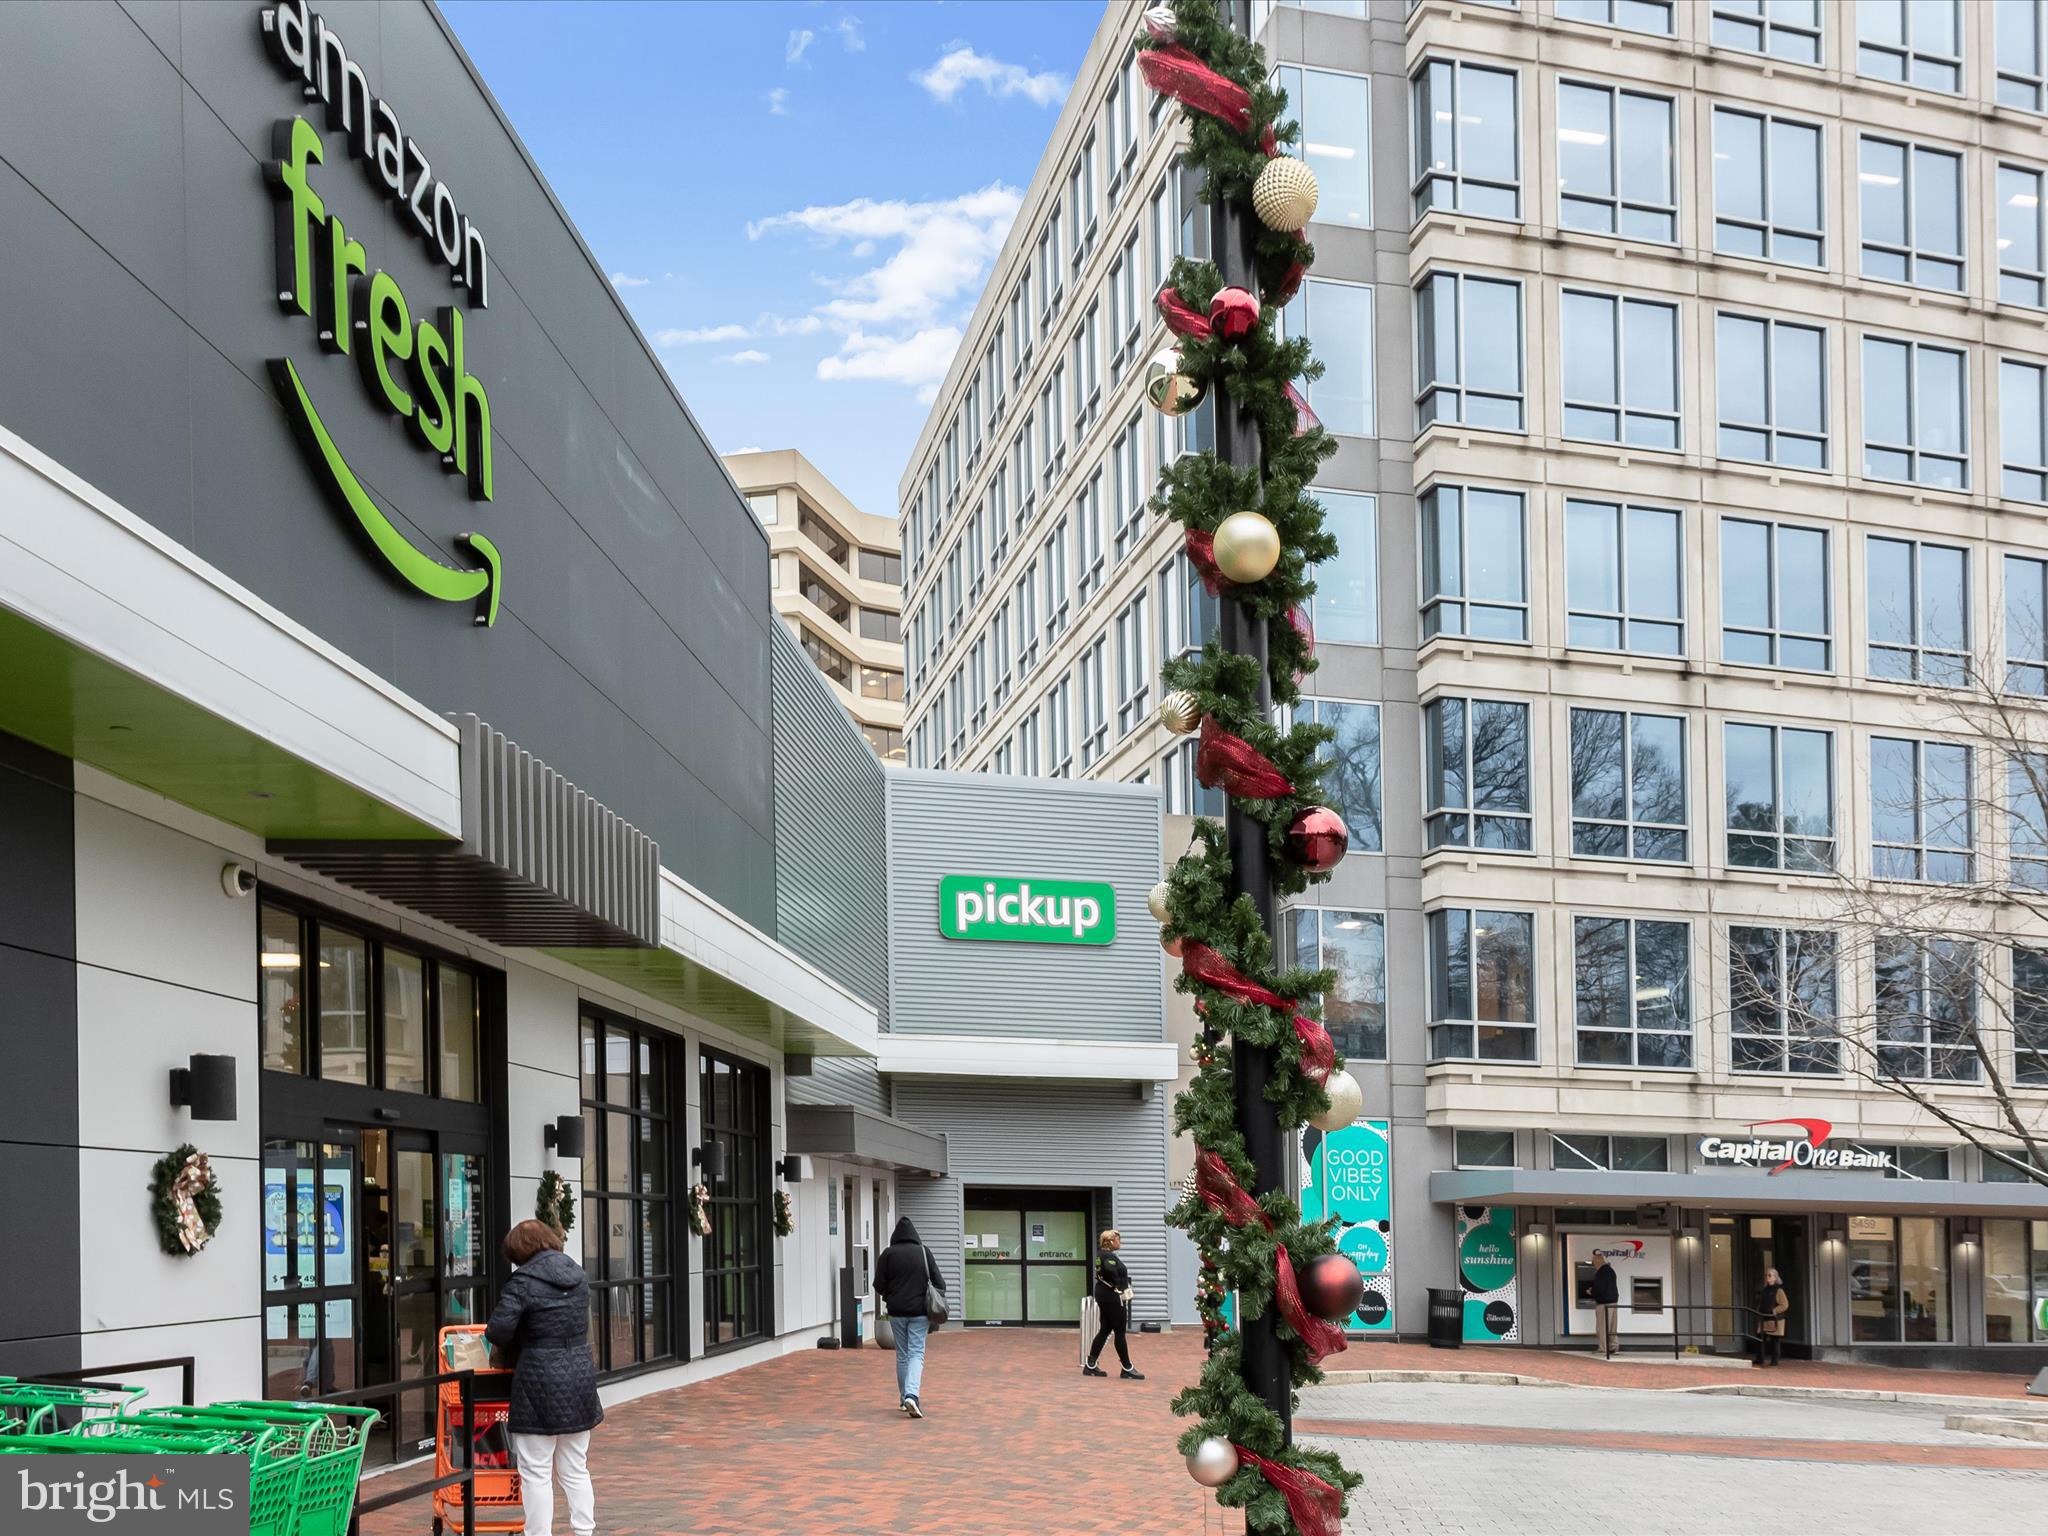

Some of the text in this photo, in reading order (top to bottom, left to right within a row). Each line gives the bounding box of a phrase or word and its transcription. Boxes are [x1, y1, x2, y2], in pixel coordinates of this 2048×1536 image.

[266, 0, 489, 310] amazon
[270, 116, 494, 502] fresh
[957, 883, 1100, 937] pickup
[1327, 1149, 1384, 1166] GOOD
[1329, 1167, 1383, 1184] VIBES
[1331, 1185, 1381, 1201] ONLY
[972, 1249, 1073, 1259] employee entrance
[1478, 1244, 1500, 1253] hello
[1463, 1254, 1515, 1265] sunshine
